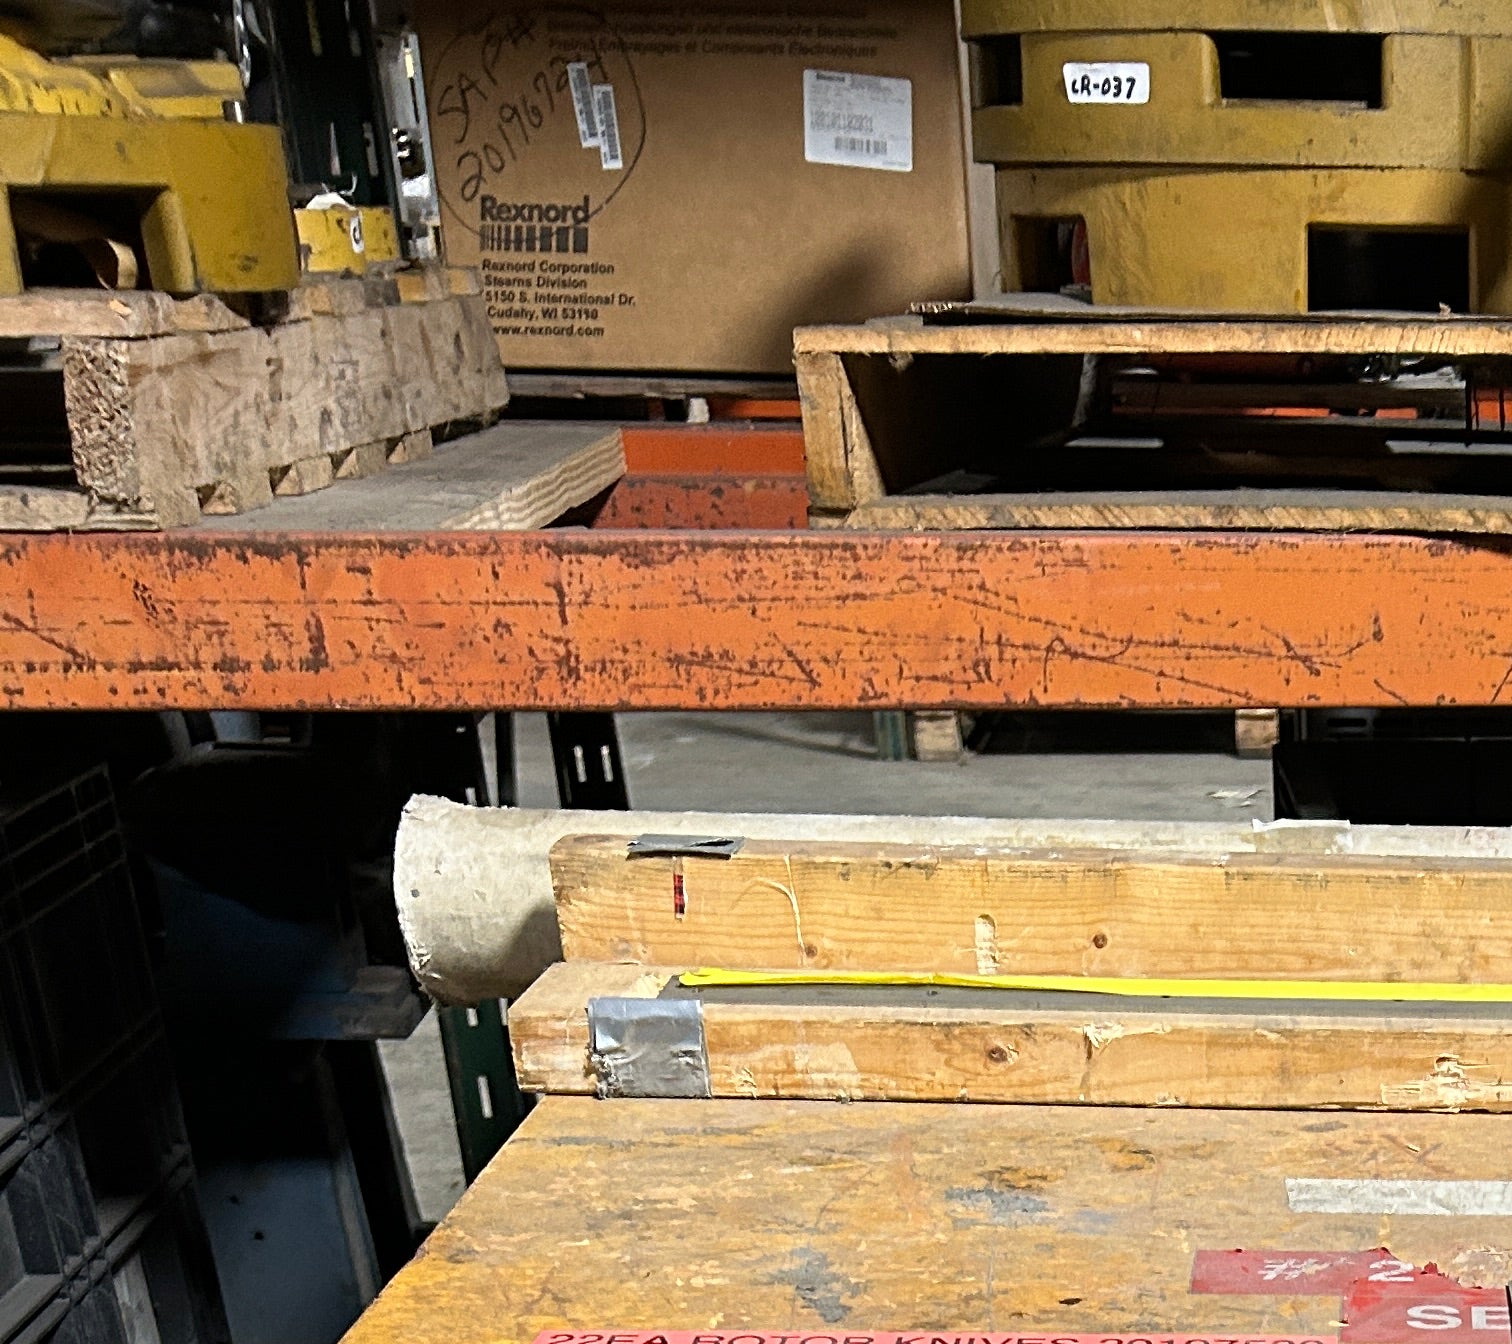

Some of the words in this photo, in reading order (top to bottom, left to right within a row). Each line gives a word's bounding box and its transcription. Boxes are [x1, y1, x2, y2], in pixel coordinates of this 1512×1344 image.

[480, 194, 590, 224] Rexnord
[482, 258, 536, 273] Rexnord
[539, 259, 615, 275] Corporation
[484, 275, 532, 288] Stearns
[536, 276, 588, 289] Division
[485, 290, 515, 303] 5150
[534, 292, 615, 306] International
[618, 293, 637, 307] Dr.
[487, 306, 539, 322] Cudahy,
[542, 307, 558, 319] WI
[493, 323, 605, 337] www.rexnord.com
[1367, 1260, 1415, 1283] 2
[1406, 1305, 1510, 1331] SE
